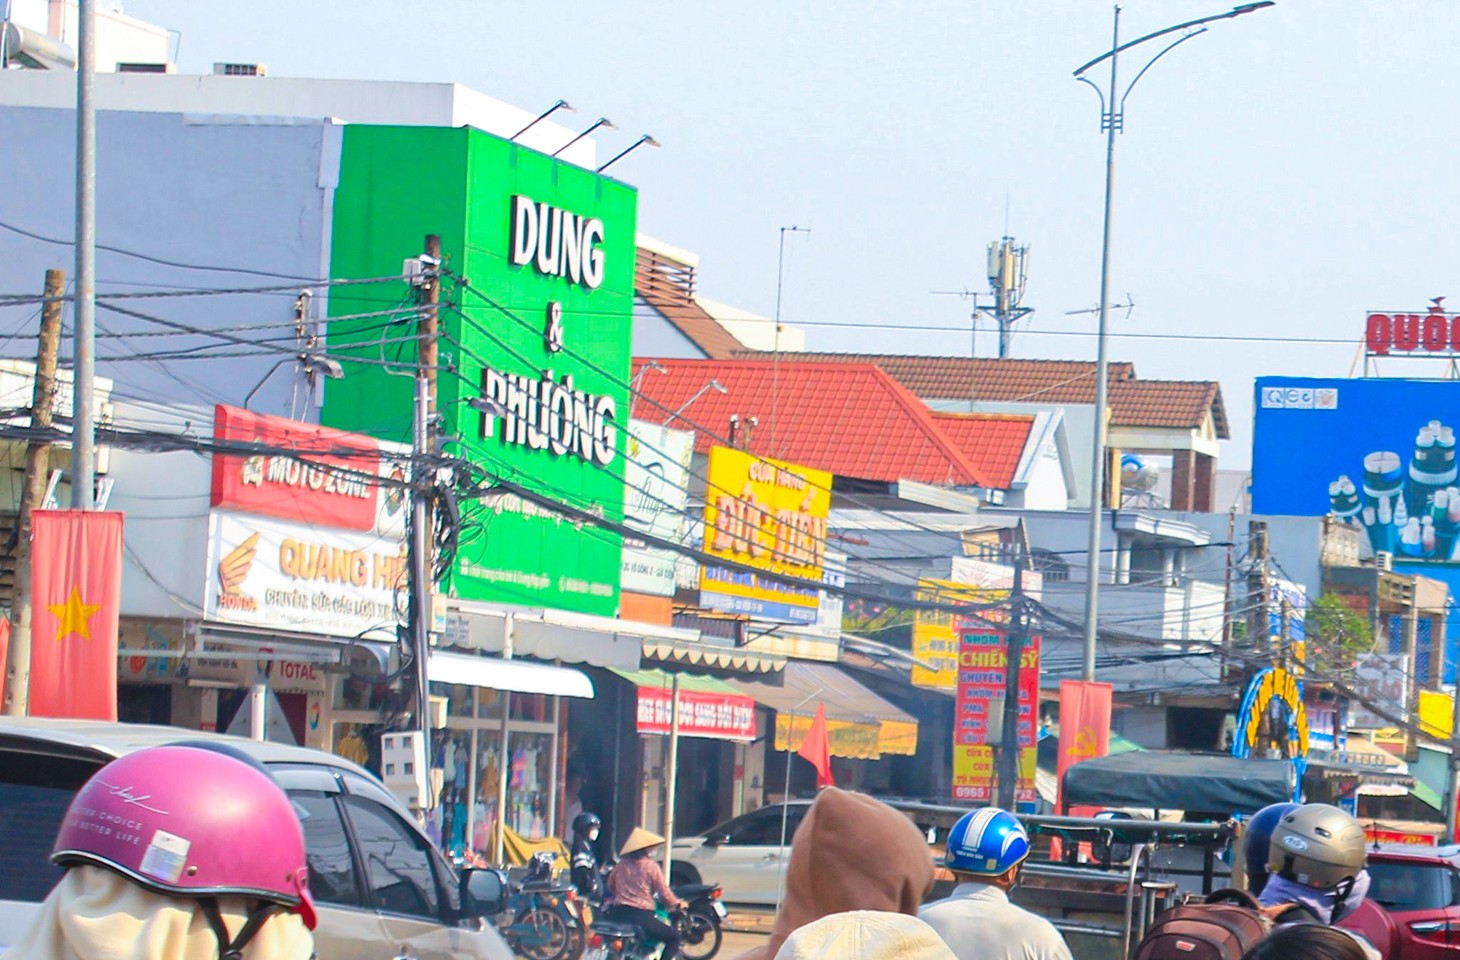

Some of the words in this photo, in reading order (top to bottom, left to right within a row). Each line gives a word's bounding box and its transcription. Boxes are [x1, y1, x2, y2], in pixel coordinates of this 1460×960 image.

[511, 195, 604, 289] DUNG
[549, 301, 562, 352] &
[280, 537, 367, 587] QUANG
[220, 593, 258, 613] HONDA
[280, 660, 316, 681] TOTAL
[98, 812, 144, 831] CHOICE
[115, 831, 142, 846] LIFE
